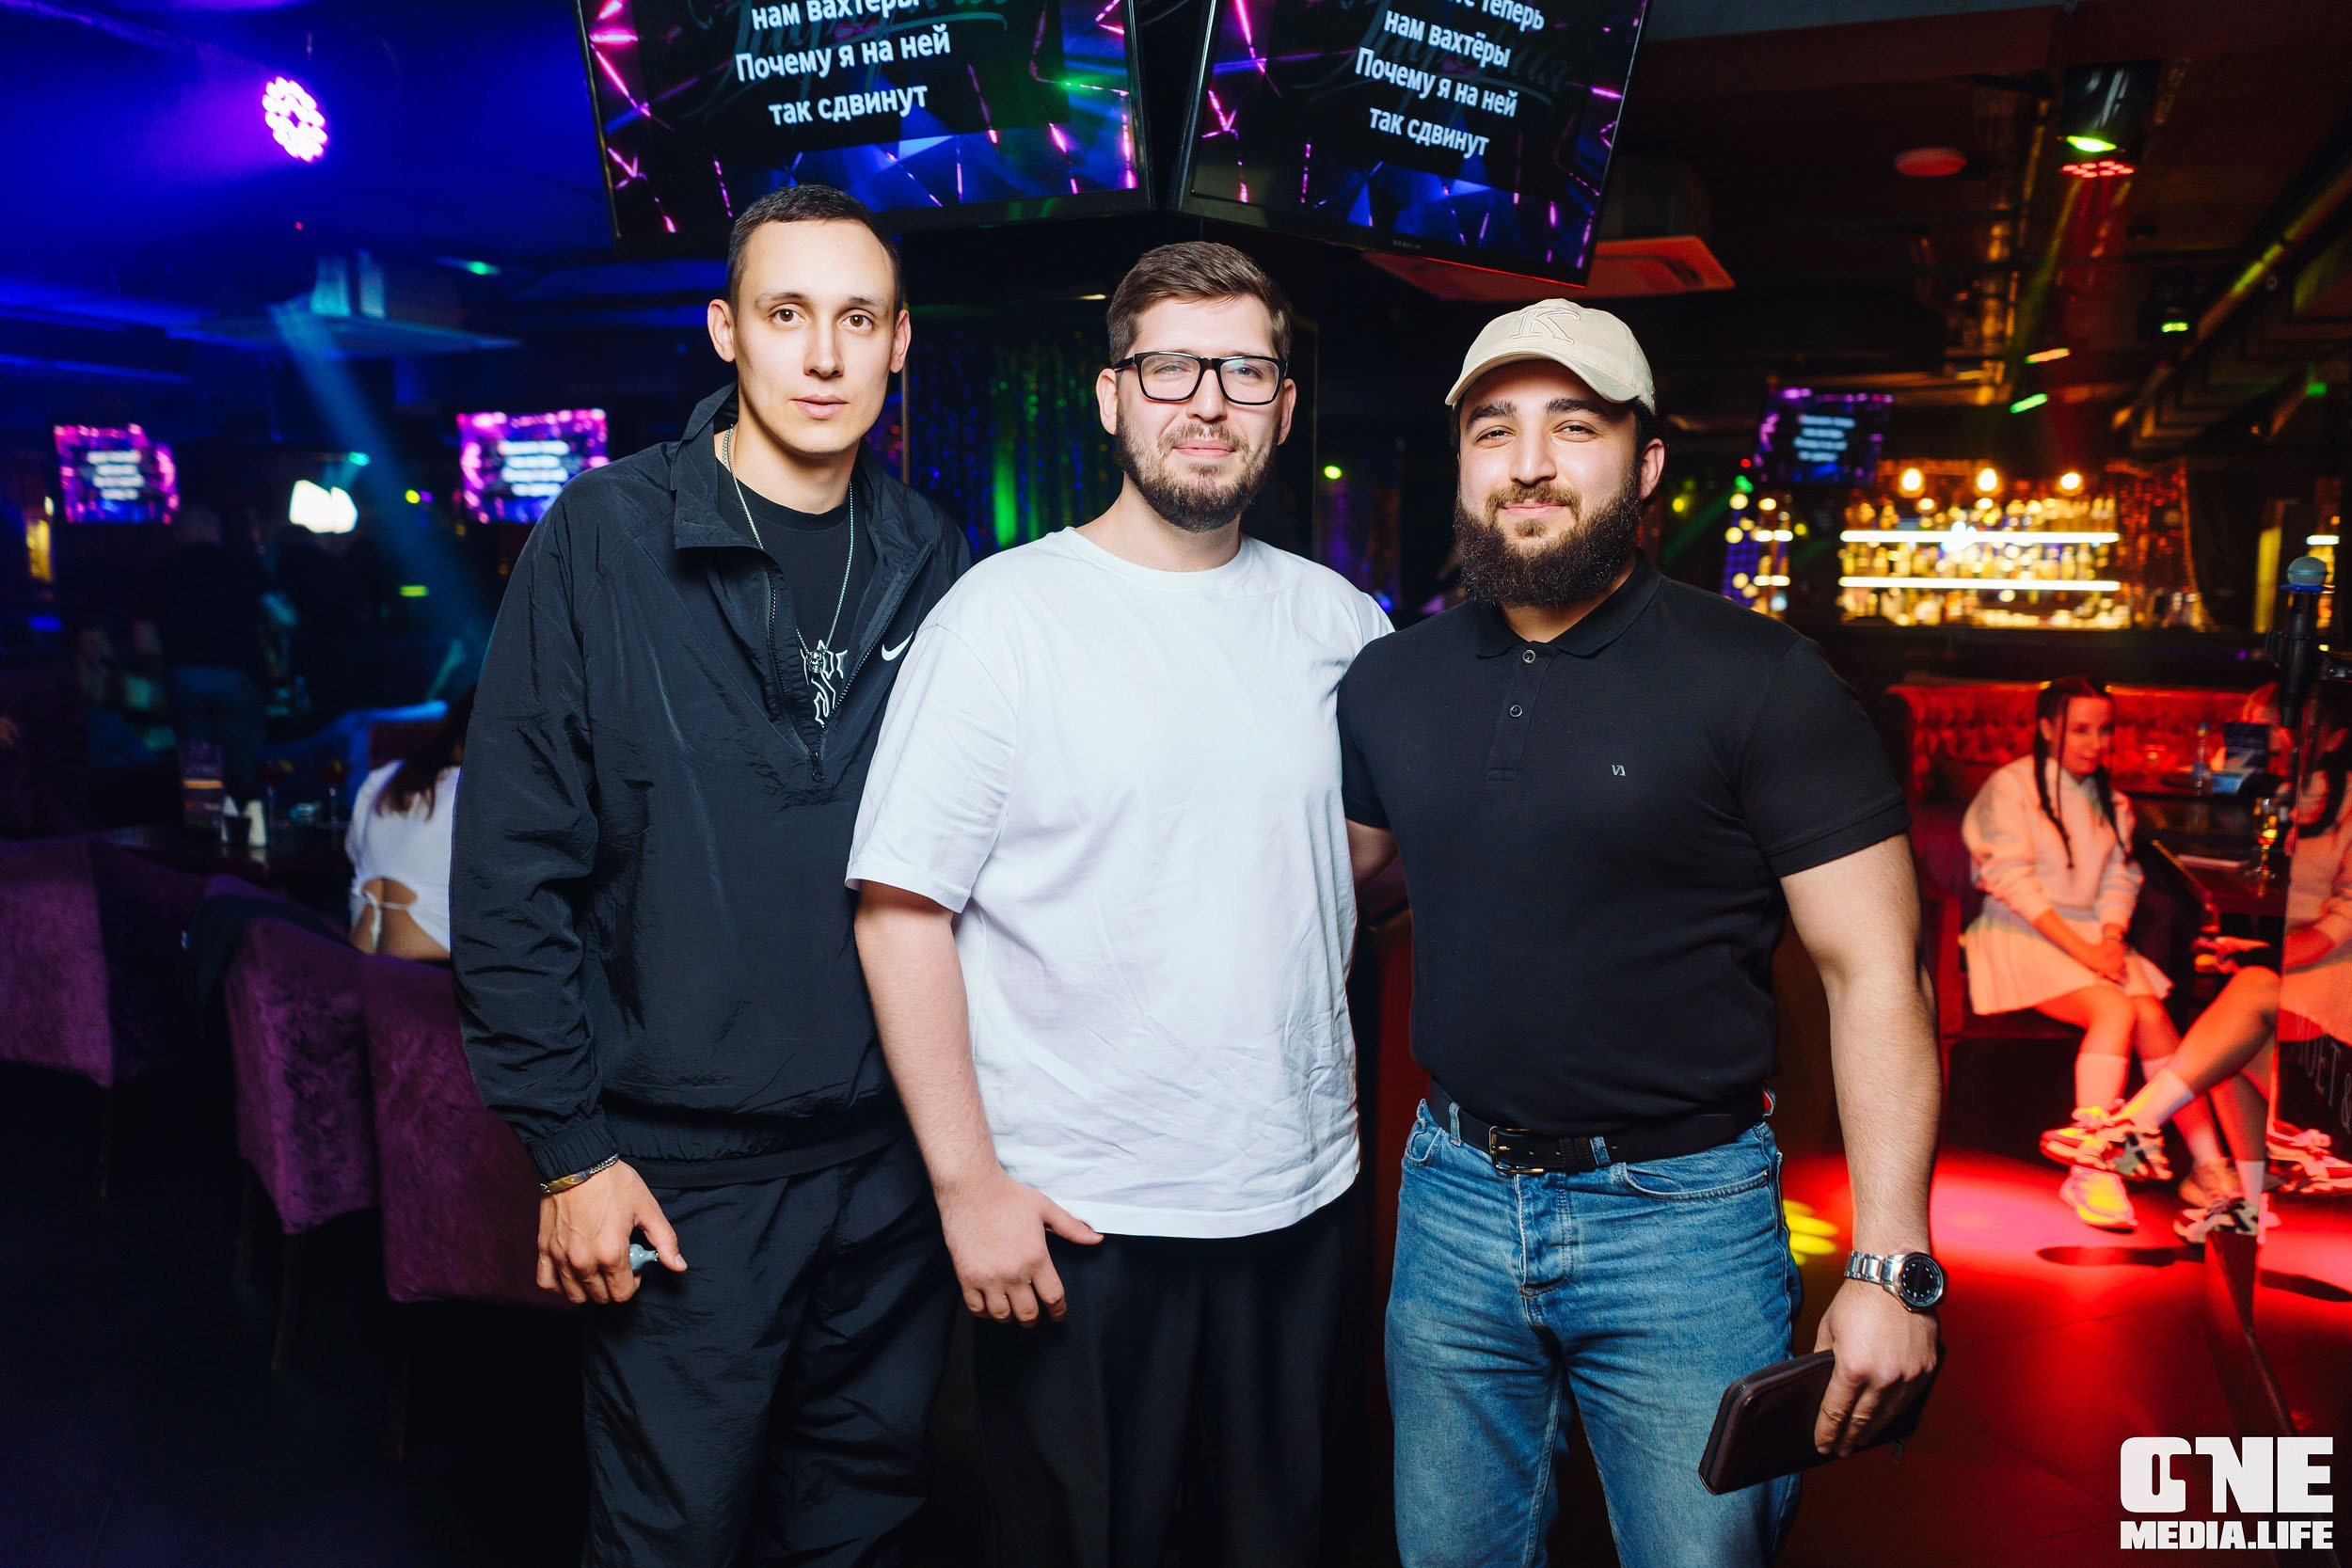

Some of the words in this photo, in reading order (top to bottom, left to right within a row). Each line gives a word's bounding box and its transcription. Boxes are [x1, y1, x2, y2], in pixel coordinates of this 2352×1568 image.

[752, 2, 800, 30] нам
[1384, 9, 1425, 41] нам
[1427, 24, 1511, 69] вахтёры
[735, 48, 833, 82] Почему
[838, 45, 855, 69] я
[862, 40, 894, 65] на
[899, 24, 951, 59] ней
[769, 99, 813, 125] так
[817, 85, 928, 122] сдвинут
[1355, 46, 1437, 100] Почему
[1437, 78, 1452, 99] я
[1454, 82, 1479, 107] на
[1481, 89, 1518, 118] ней
[1369, 107, 1405, 135] так
[1406, 119, 1490, 159] сдвинут
[1508, 306, 1581, 346] K
